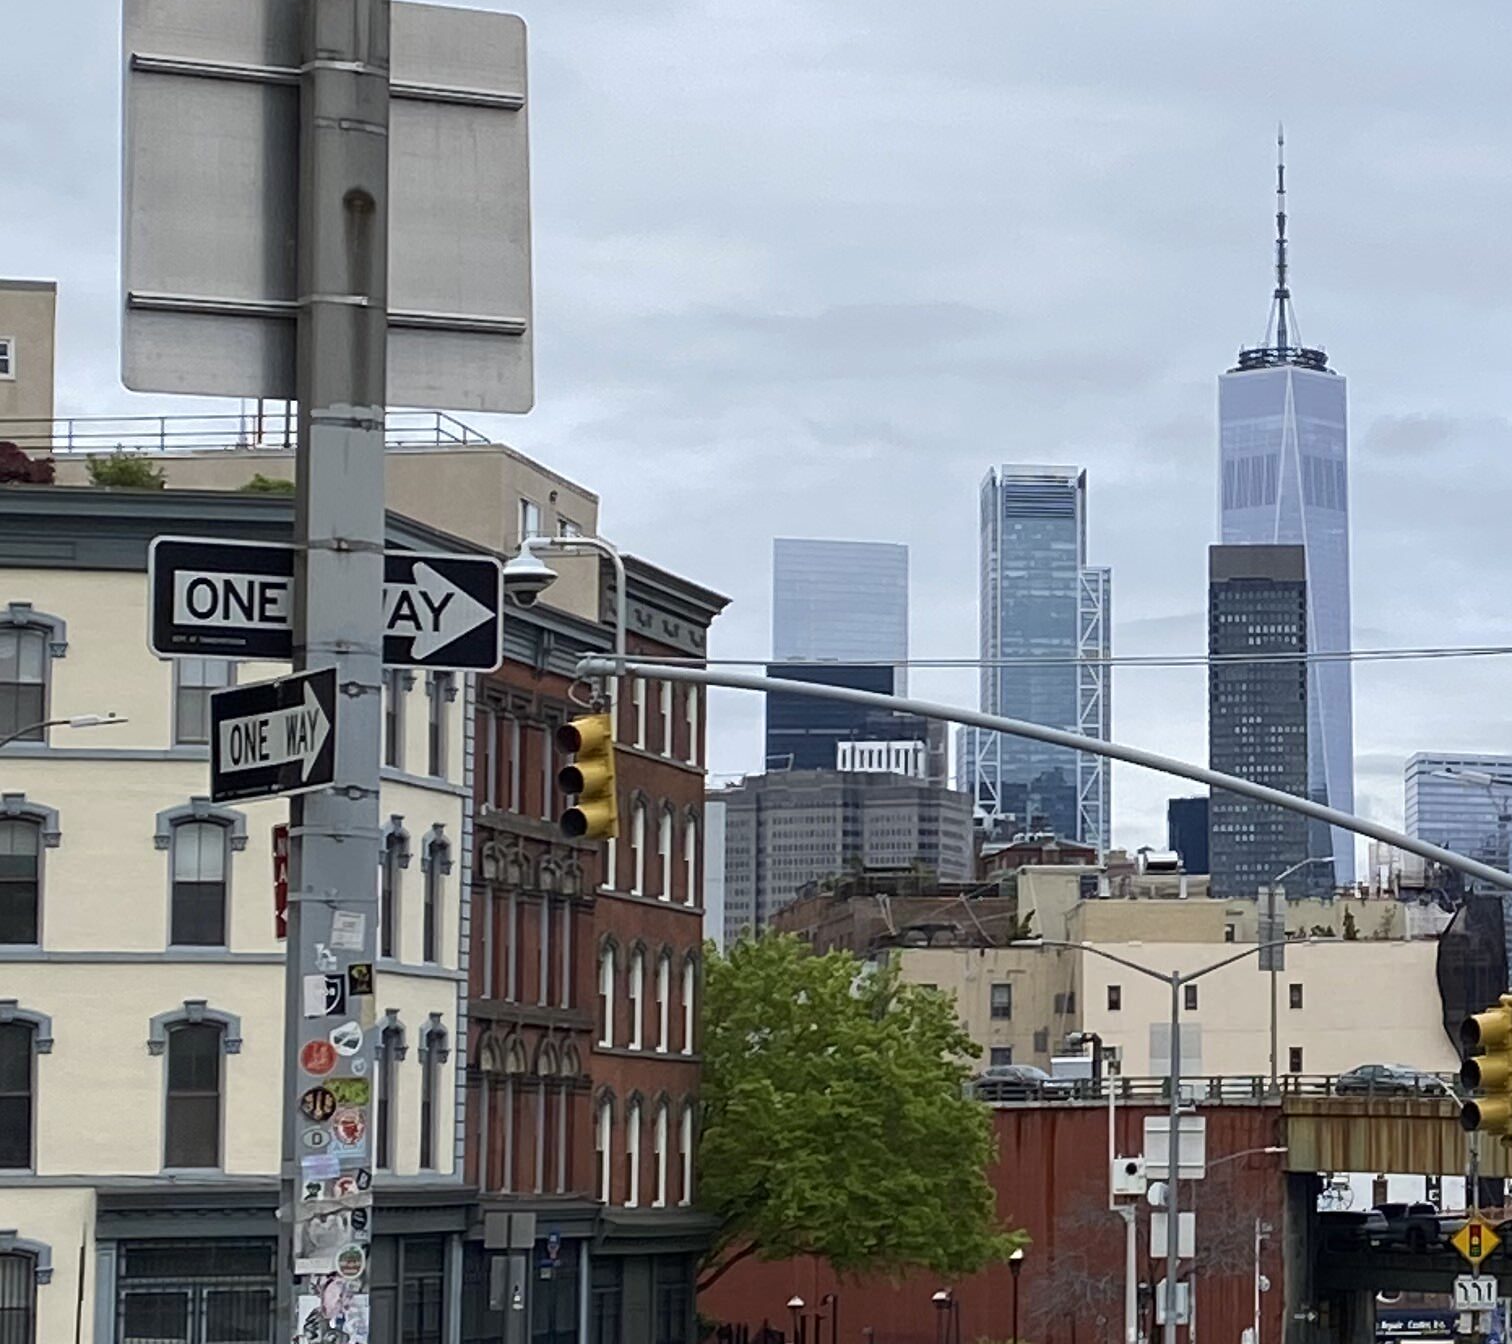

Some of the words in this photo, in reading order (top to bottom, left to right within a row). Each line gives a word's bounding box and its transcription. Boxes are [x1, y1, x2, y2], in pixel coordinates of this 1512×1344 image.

[185, 577, 288, 623] ONE
[382, 588, 455, 633] AY
[230, 719, 270, 766] ONE
[285, 708, 320, 756] WAY
